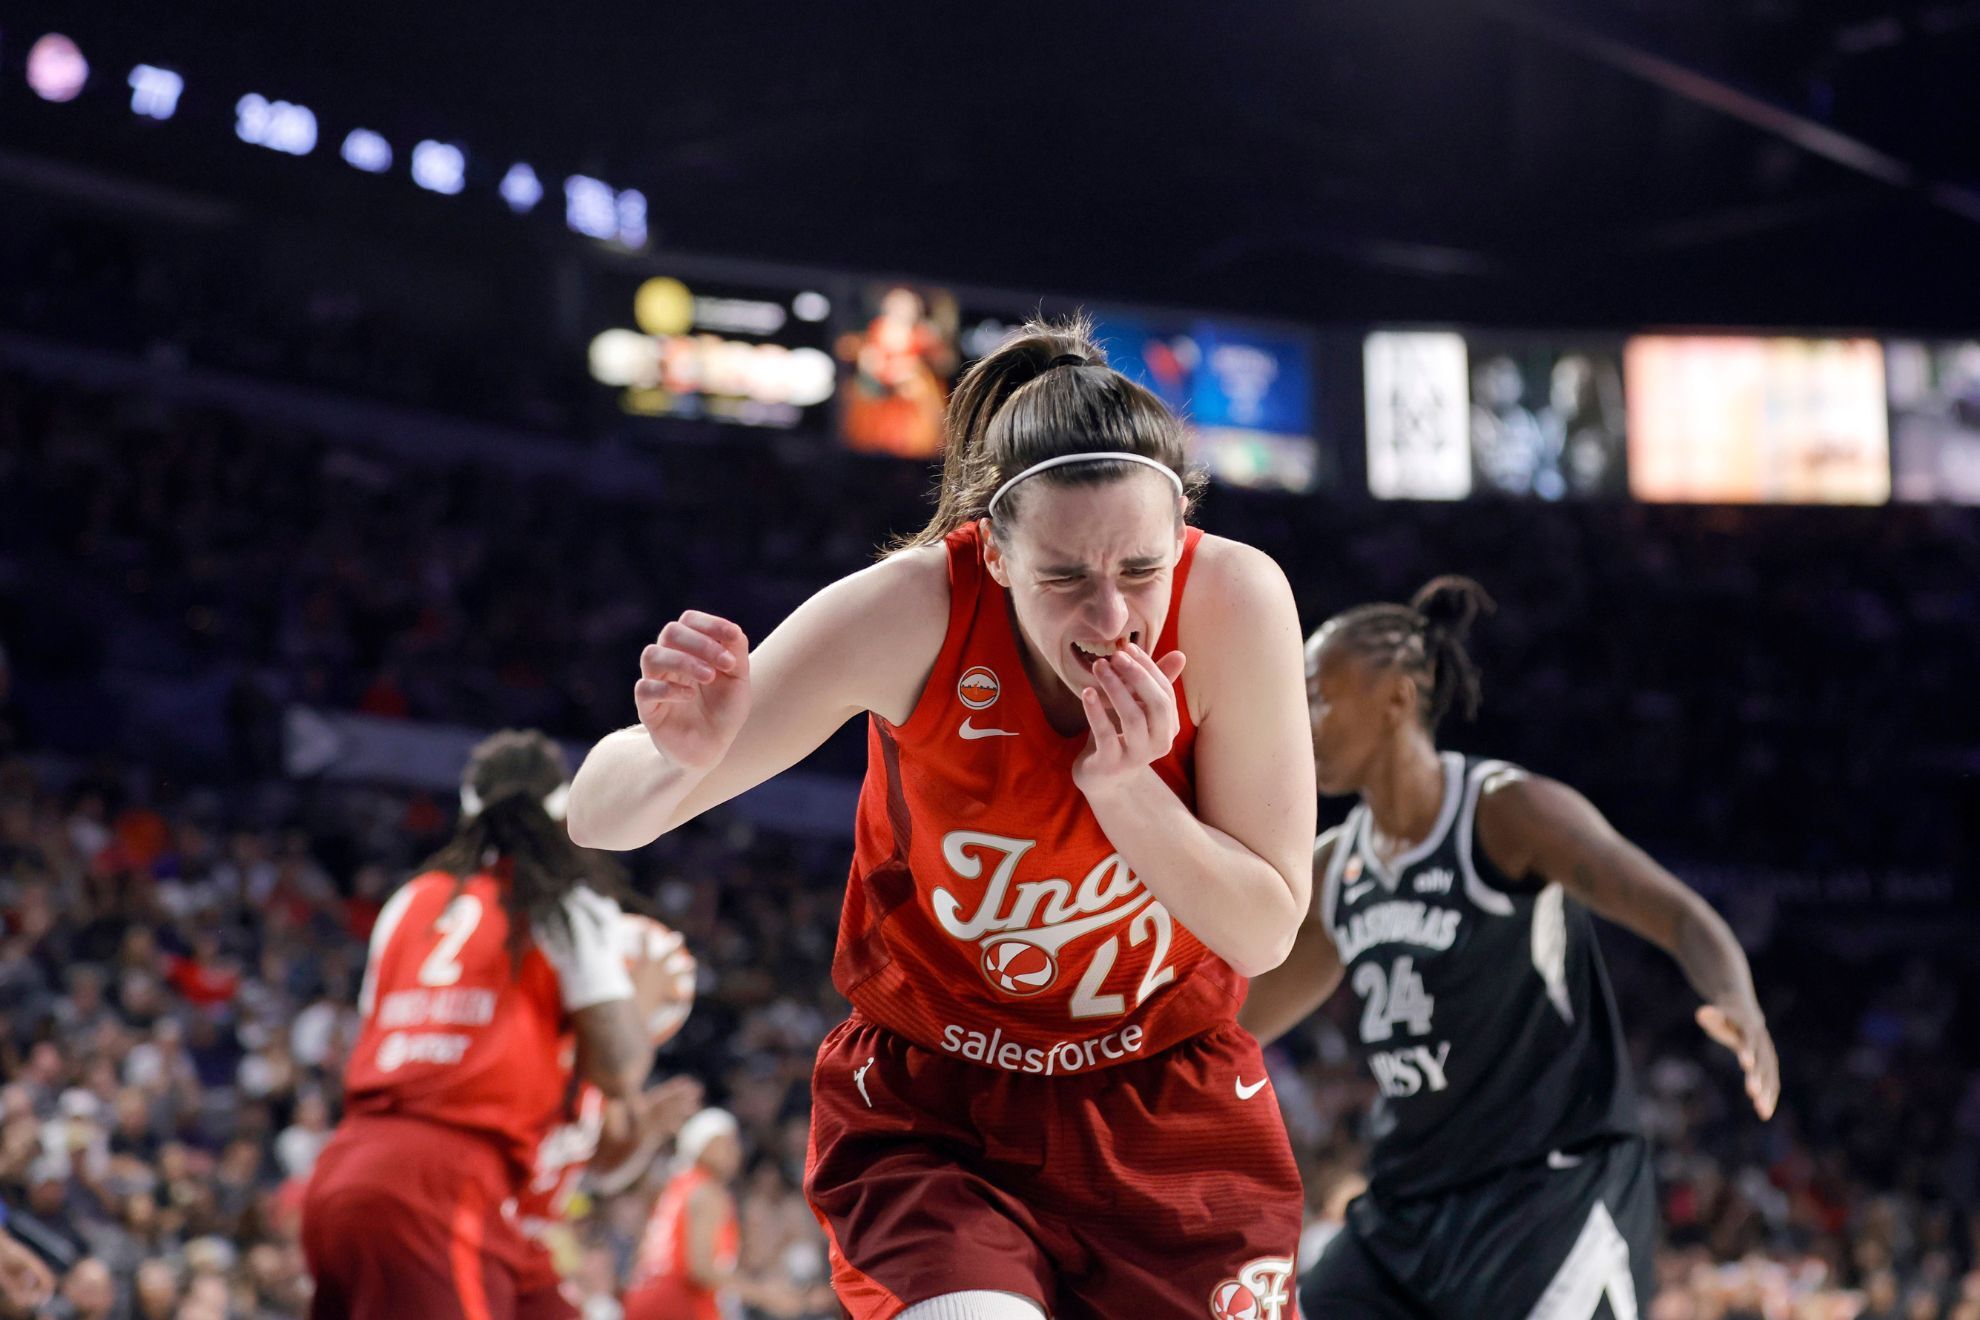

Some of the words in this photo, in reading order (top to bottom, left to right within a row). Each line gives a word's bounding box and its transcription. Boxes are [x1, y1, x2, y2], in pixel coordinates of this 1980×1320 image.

[418, 893, 484, 988] 2
[1351, 954, 1435, 1043] 24
[940, 1024, 1143, 1076] salesforce
